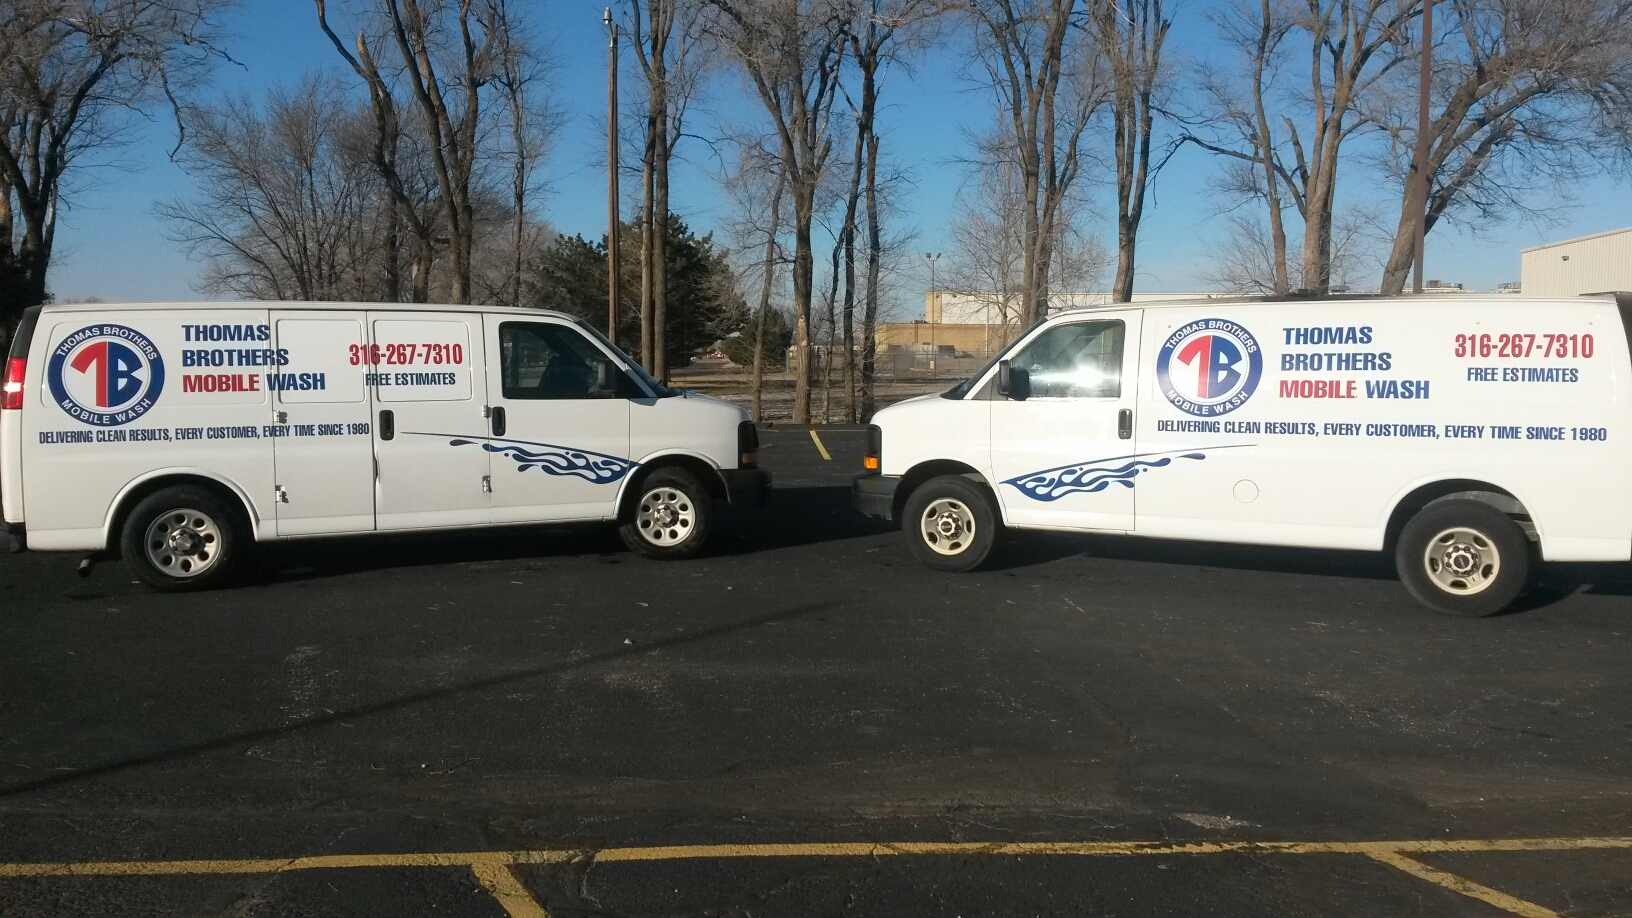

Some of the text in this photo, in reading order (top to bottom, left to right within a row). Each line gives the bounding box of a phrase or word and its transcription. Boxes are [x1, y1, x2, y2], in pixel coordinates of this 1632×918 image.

[56, 326, 157, 360] THOMAS BROTHERS
[181, 324, 270, 342] THOMAS
[1165, 320, 1257, 353] THOMAS BROTHERS
[1283, 326, 1373, 345] THOMAS
[349, 343, 463, 366] 316-267-7310
[1454, 333, 1594, 358] 316-267-7310
[182, 348, 289, 367] BROTHERS
[1281, 352, 1392, 371] BROTHERS
[182, 372, 326, 392] MOBILE WASH
[365, 372, 456, 386] FREE ESTIMATES
[1467, 367, 1579, 383] FREE ESTIMATES
[1279, 379, 1430, 399] MOBILE WASH
[61, 398, 152, 424] MOBILE WASH
[1166, 389, 1248, 414] MOBILE WASH
[39, 422, 369, 444] DELIVERING CLEAN RESULTS, EVERY CUSTOMER, EVERY TIME SINCE 1980
[1157, 420, 1607, 441] DELIVERING CLEAN RESULTS, EVERY CUSTOMER, EVERY TIME SINCE 1980
